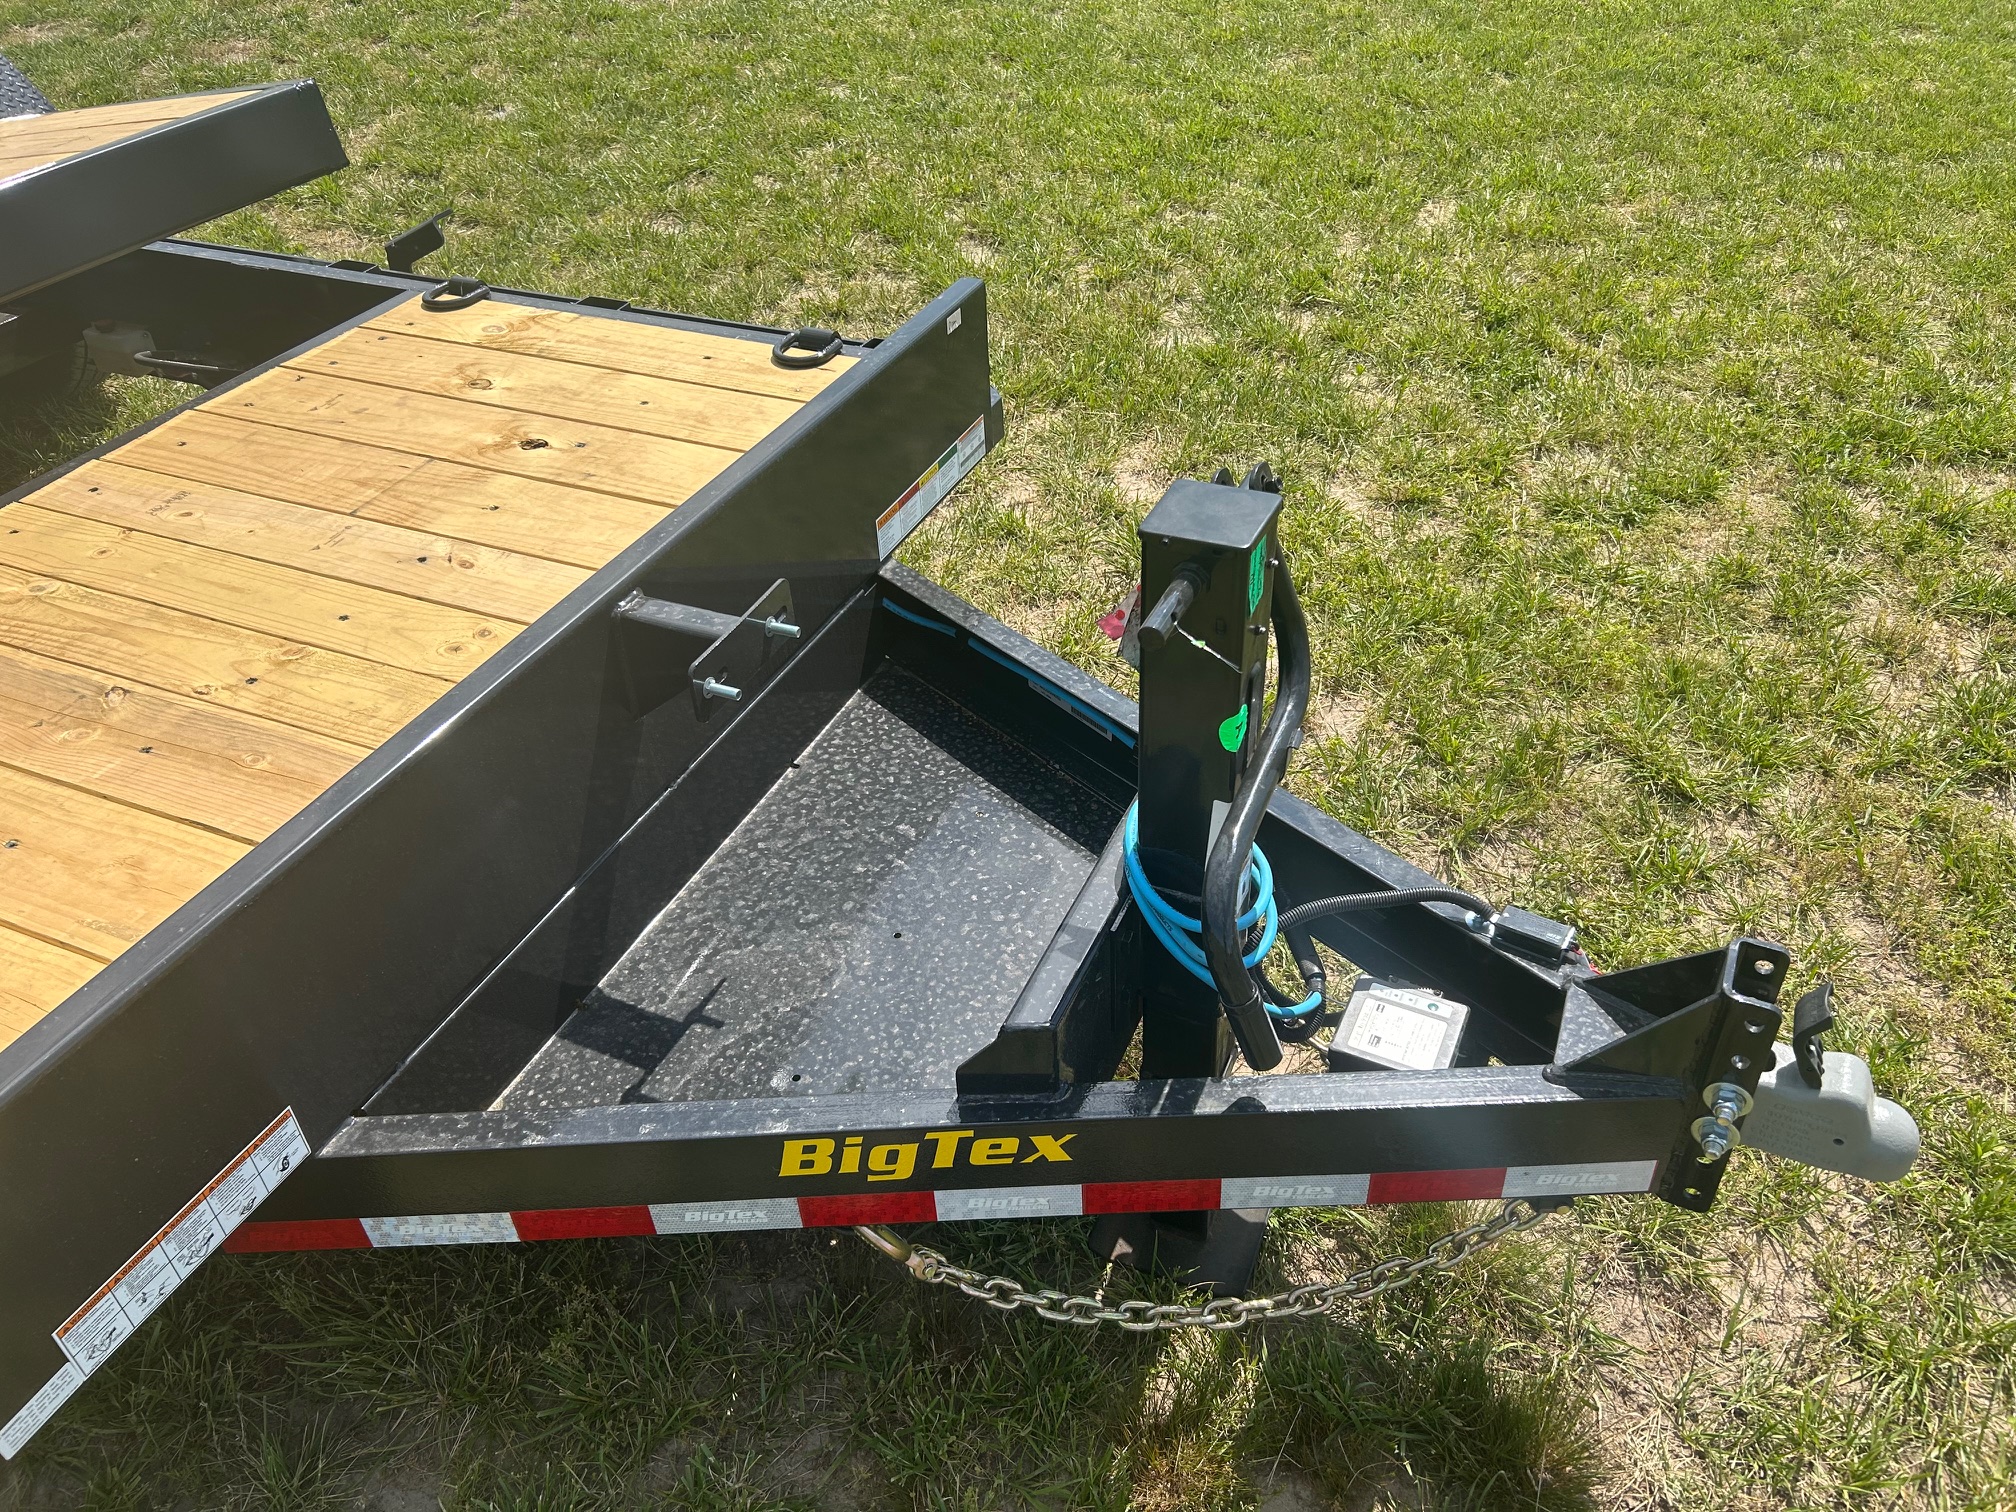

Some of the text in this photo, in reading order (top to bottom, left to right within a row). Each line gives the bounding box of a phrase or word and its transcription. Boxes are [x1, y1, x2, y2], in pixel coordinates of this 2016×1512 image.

[259, 1114, 289, 1143] WARNING
[215, 1155, 247, 1185] WARNING
[778, 1129, 1078, 1182] BigTex
[1253, 1184, 1337, 1198] BigTex
[1536, 1172, 1622, 1187] BigTex
[169, 1198, 202, 1230] WARNING
[684, 1209, 768, 1223] BigTex
[967, 1196, 1050, 1210] BigTex
[120, 1243, 155, 1276] WARNING
[70, 1290, 106, 1325] WARNING
